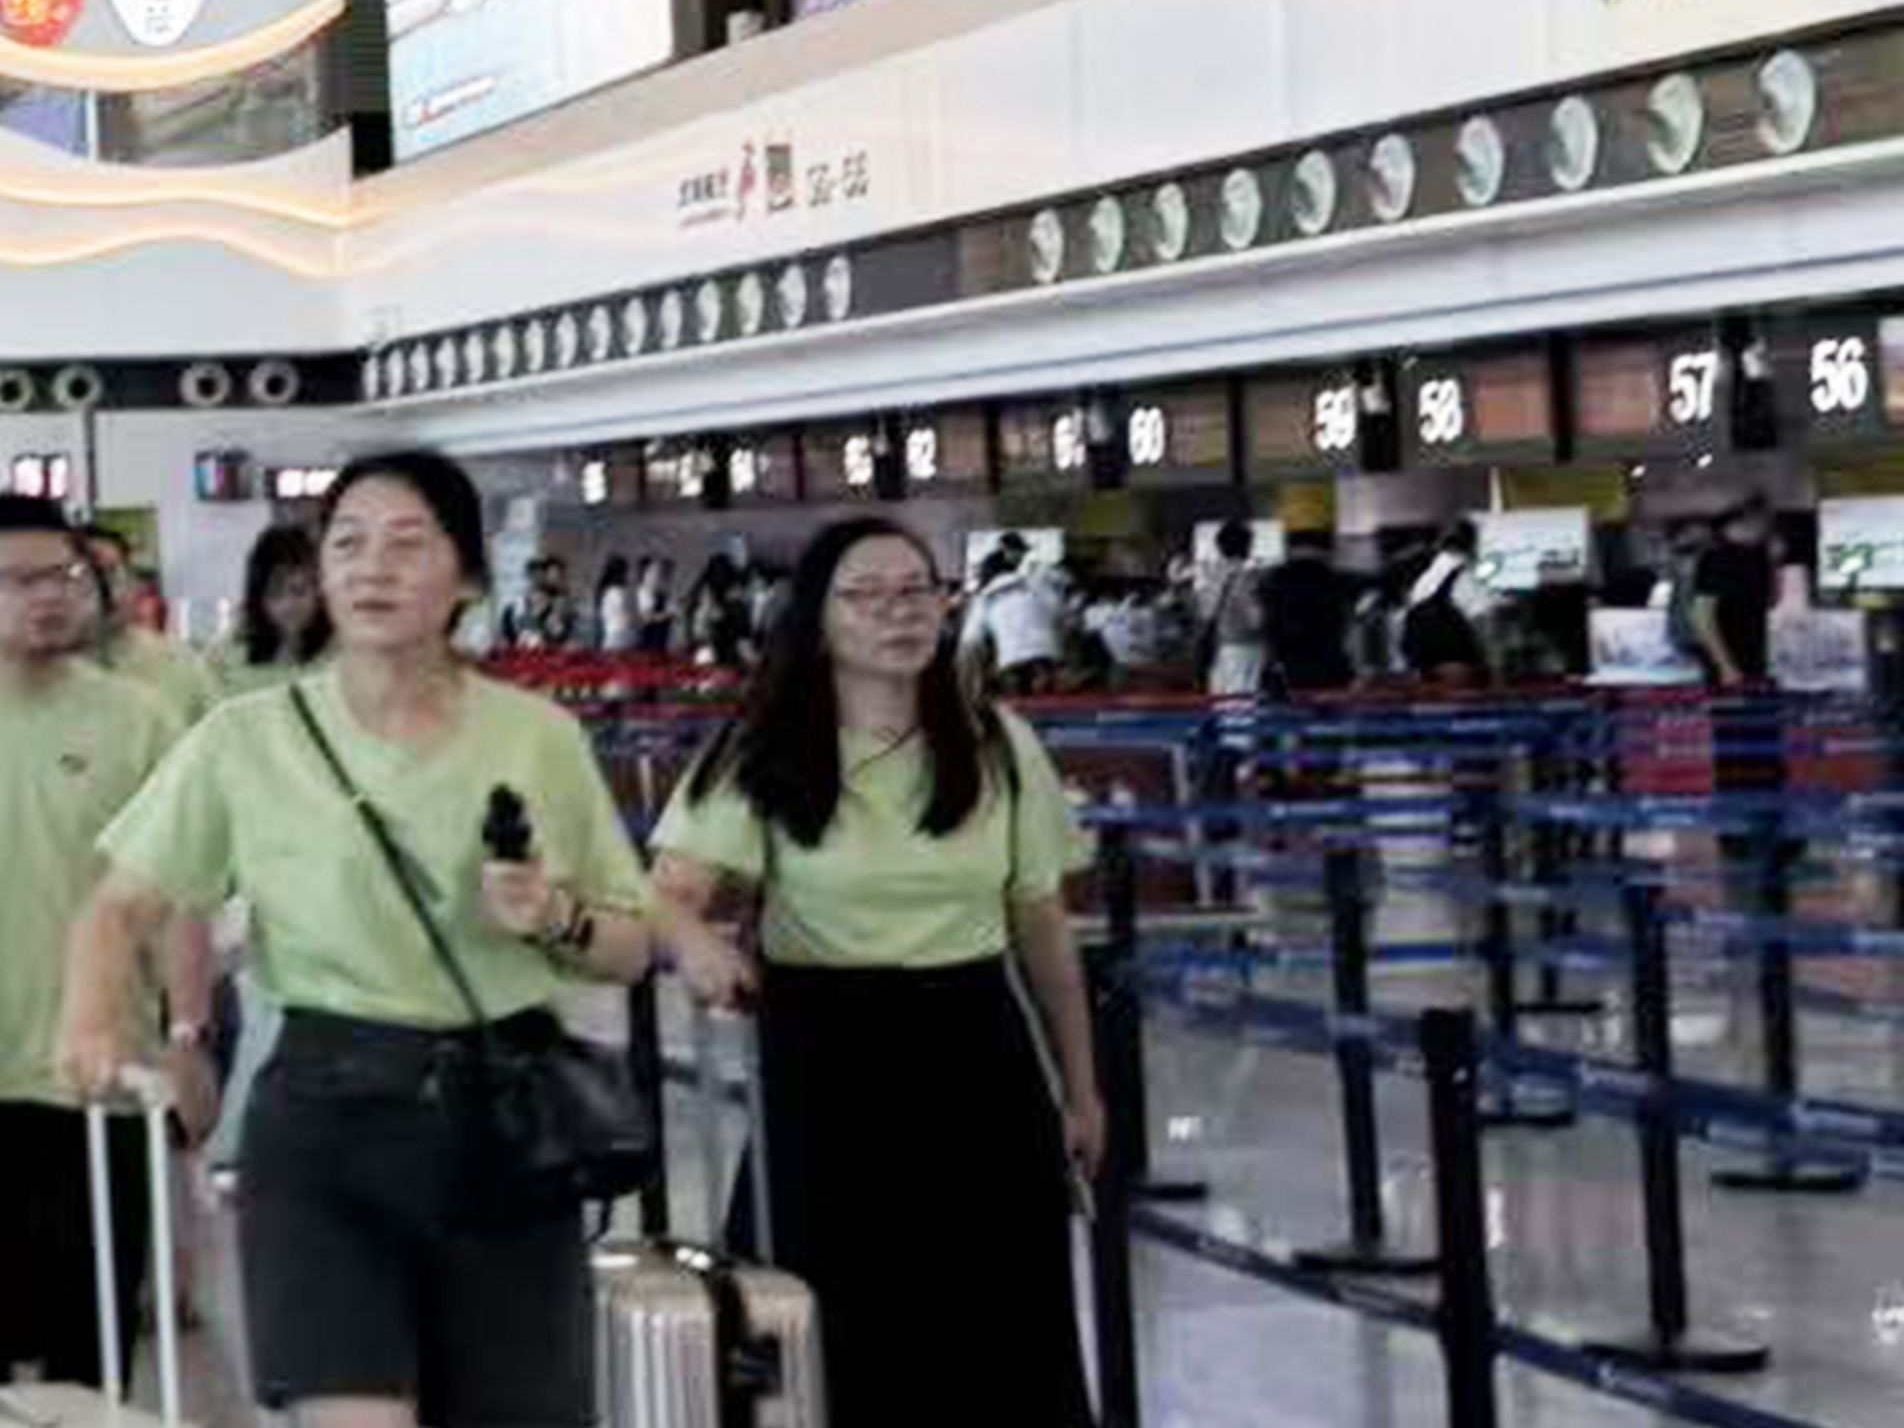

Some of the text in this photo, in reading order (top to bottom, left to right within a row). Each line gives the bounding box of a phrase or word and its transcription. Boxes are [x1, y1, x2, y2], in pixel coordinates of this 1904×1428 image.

[1670, 350, 1719, 421] 57
[1810, 336, 1867, 412] 56
[1314, 383, 1358, 450] 59
[1418, 378, 1463, 442] 58
